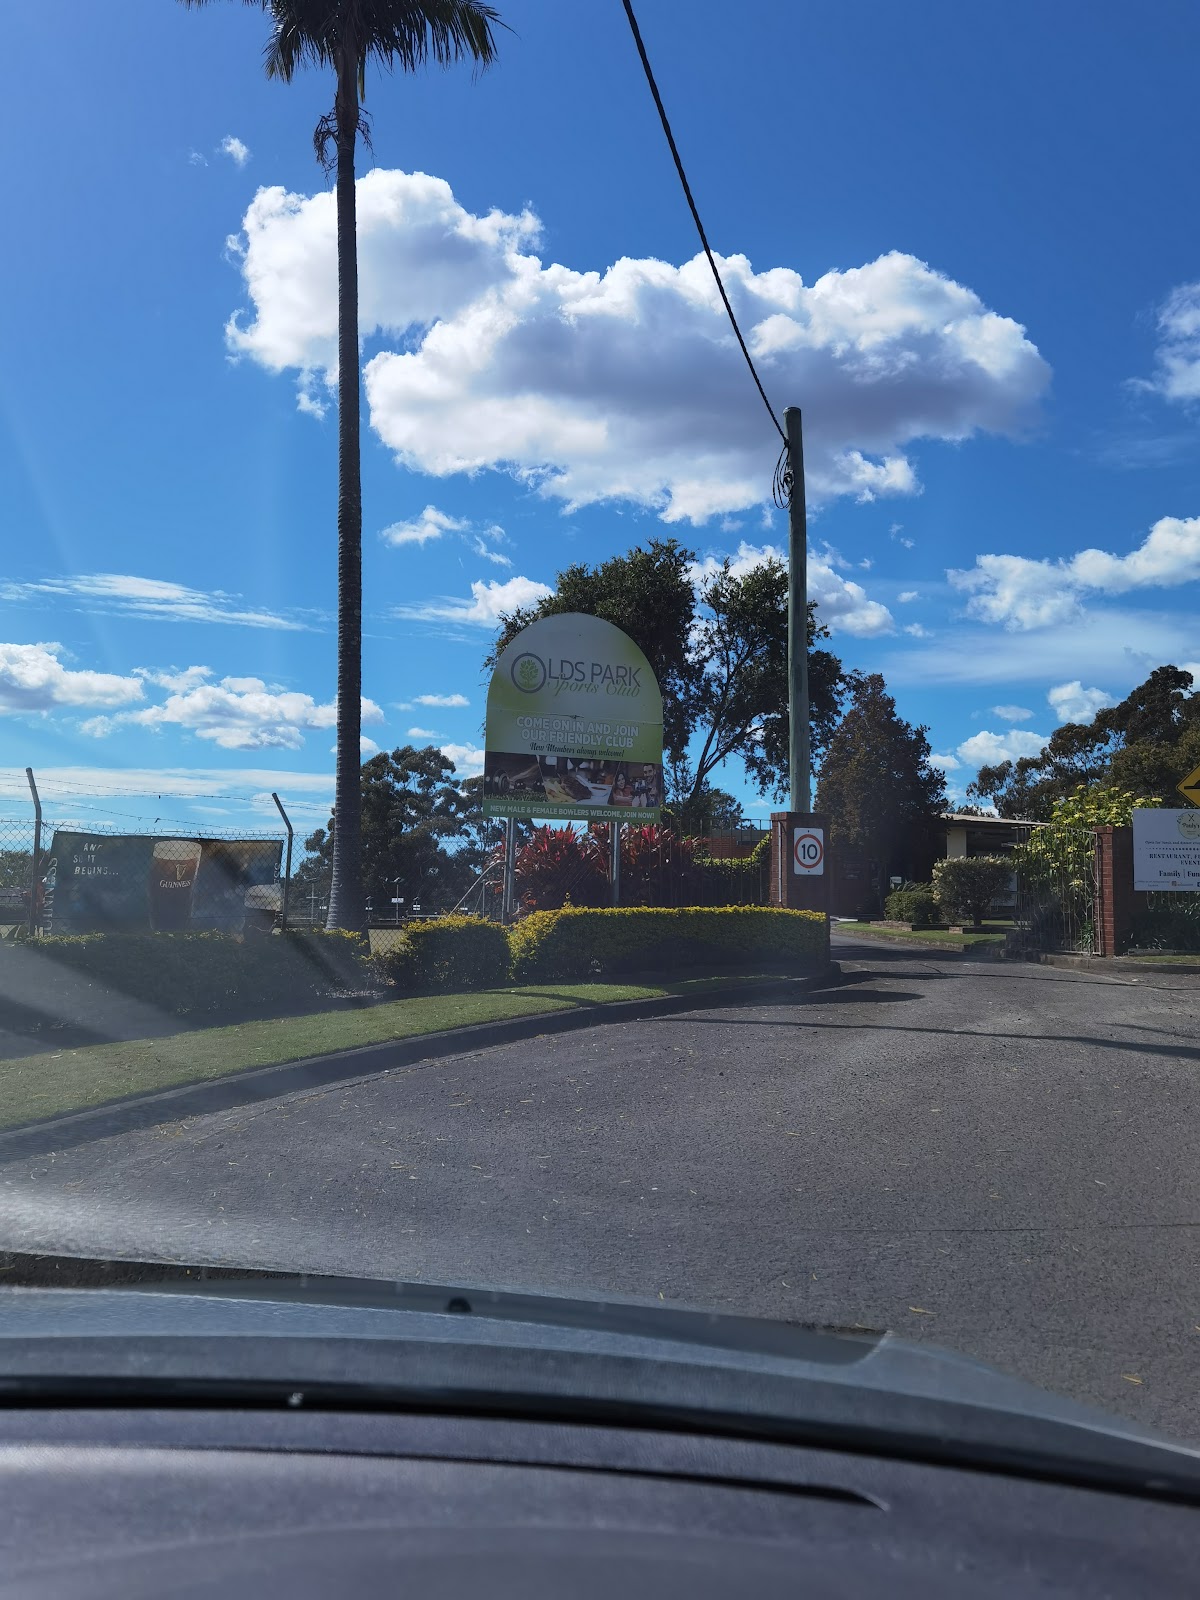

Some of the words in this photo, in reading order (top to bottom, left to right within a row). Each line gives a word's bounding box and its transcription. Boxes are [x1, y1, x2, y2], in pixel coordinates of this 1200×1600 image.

[591, 662, 641, 687] PARK
[547, 672, 600, 696] Sports
[605, 679, 640, 697] Club
[516, 716, 549, 730] COME
[552, 719, 570, 731] ON
[573, 721, 585, 733] IN
[587, 722, 611, 734] AND
[613, 725, 639, 737] JOIN
[521, 728, 547, 741] OUR
[549, 731, 603, 746] FRIENDLY
[605, 735, 634, 748] CLUB
[529, 742, 544, 751] New
[545, 743, 575, 754] Members
[576, 746, 597, 758] always
[598, 748, 625, 757] welcome!
[507, 805, 526, 813] MALE
[532, 807, 558, 815] FEMALE
[558, 808, 589, 816] BOWLERS
[590, 809, 622, 818] WELCOME,
[801, 843, 818, 860] 10
[1159, 870, 1181, 878] Family
[160, 880, 191, 888] GUINNESS
